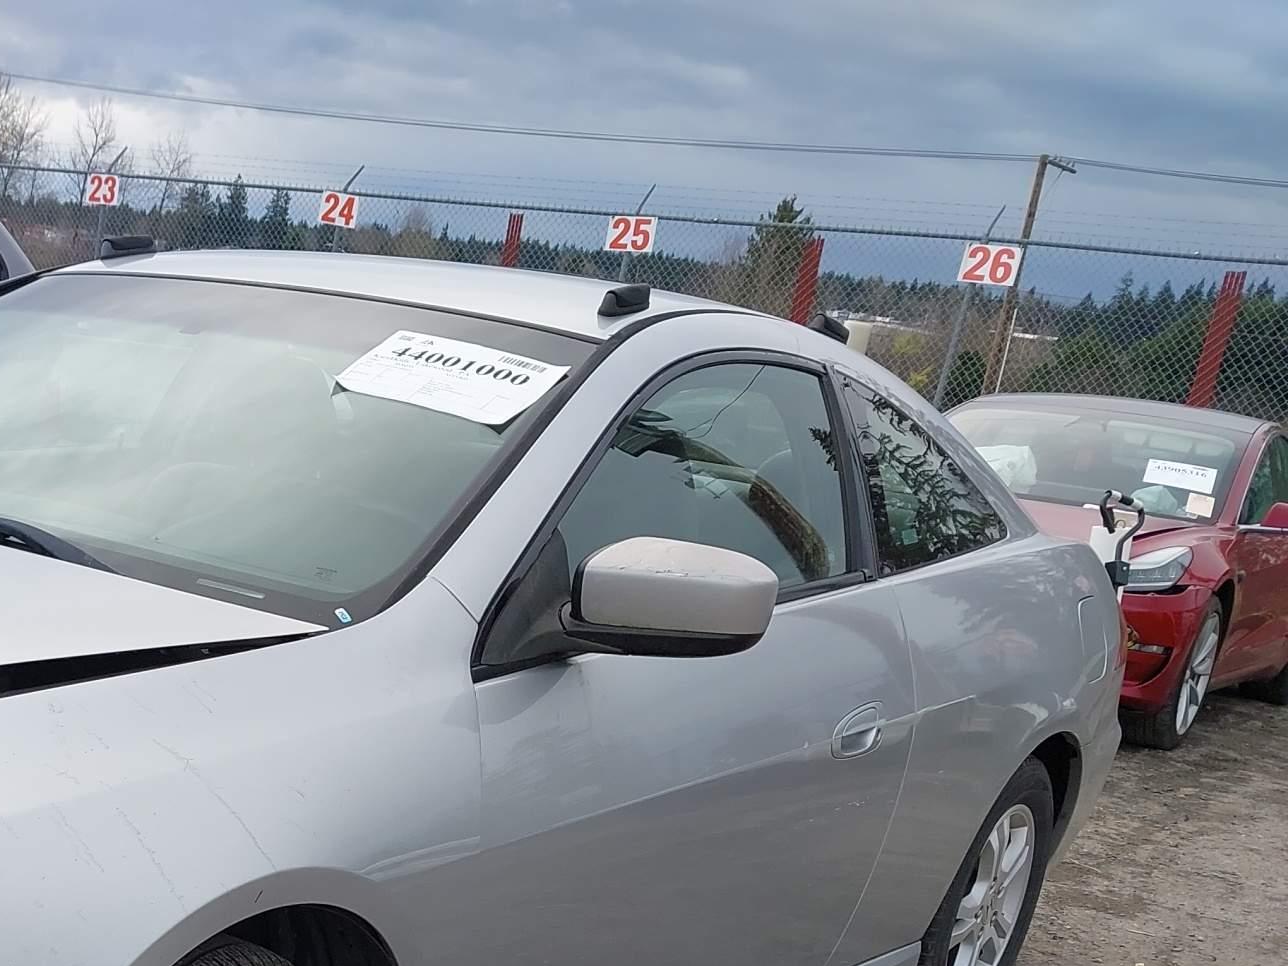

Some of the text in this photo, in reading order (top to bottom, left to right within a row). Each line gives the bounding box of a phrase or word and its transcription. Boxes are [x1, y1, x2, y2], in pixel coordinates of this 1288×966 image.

[88, 175, 117, 204] 23
[321, 193, 356, 224] 24
[609, 218, 652, 251] 25
[963, 246, 1016, 283] 26
[392, 347, 530, 386] 44001000
